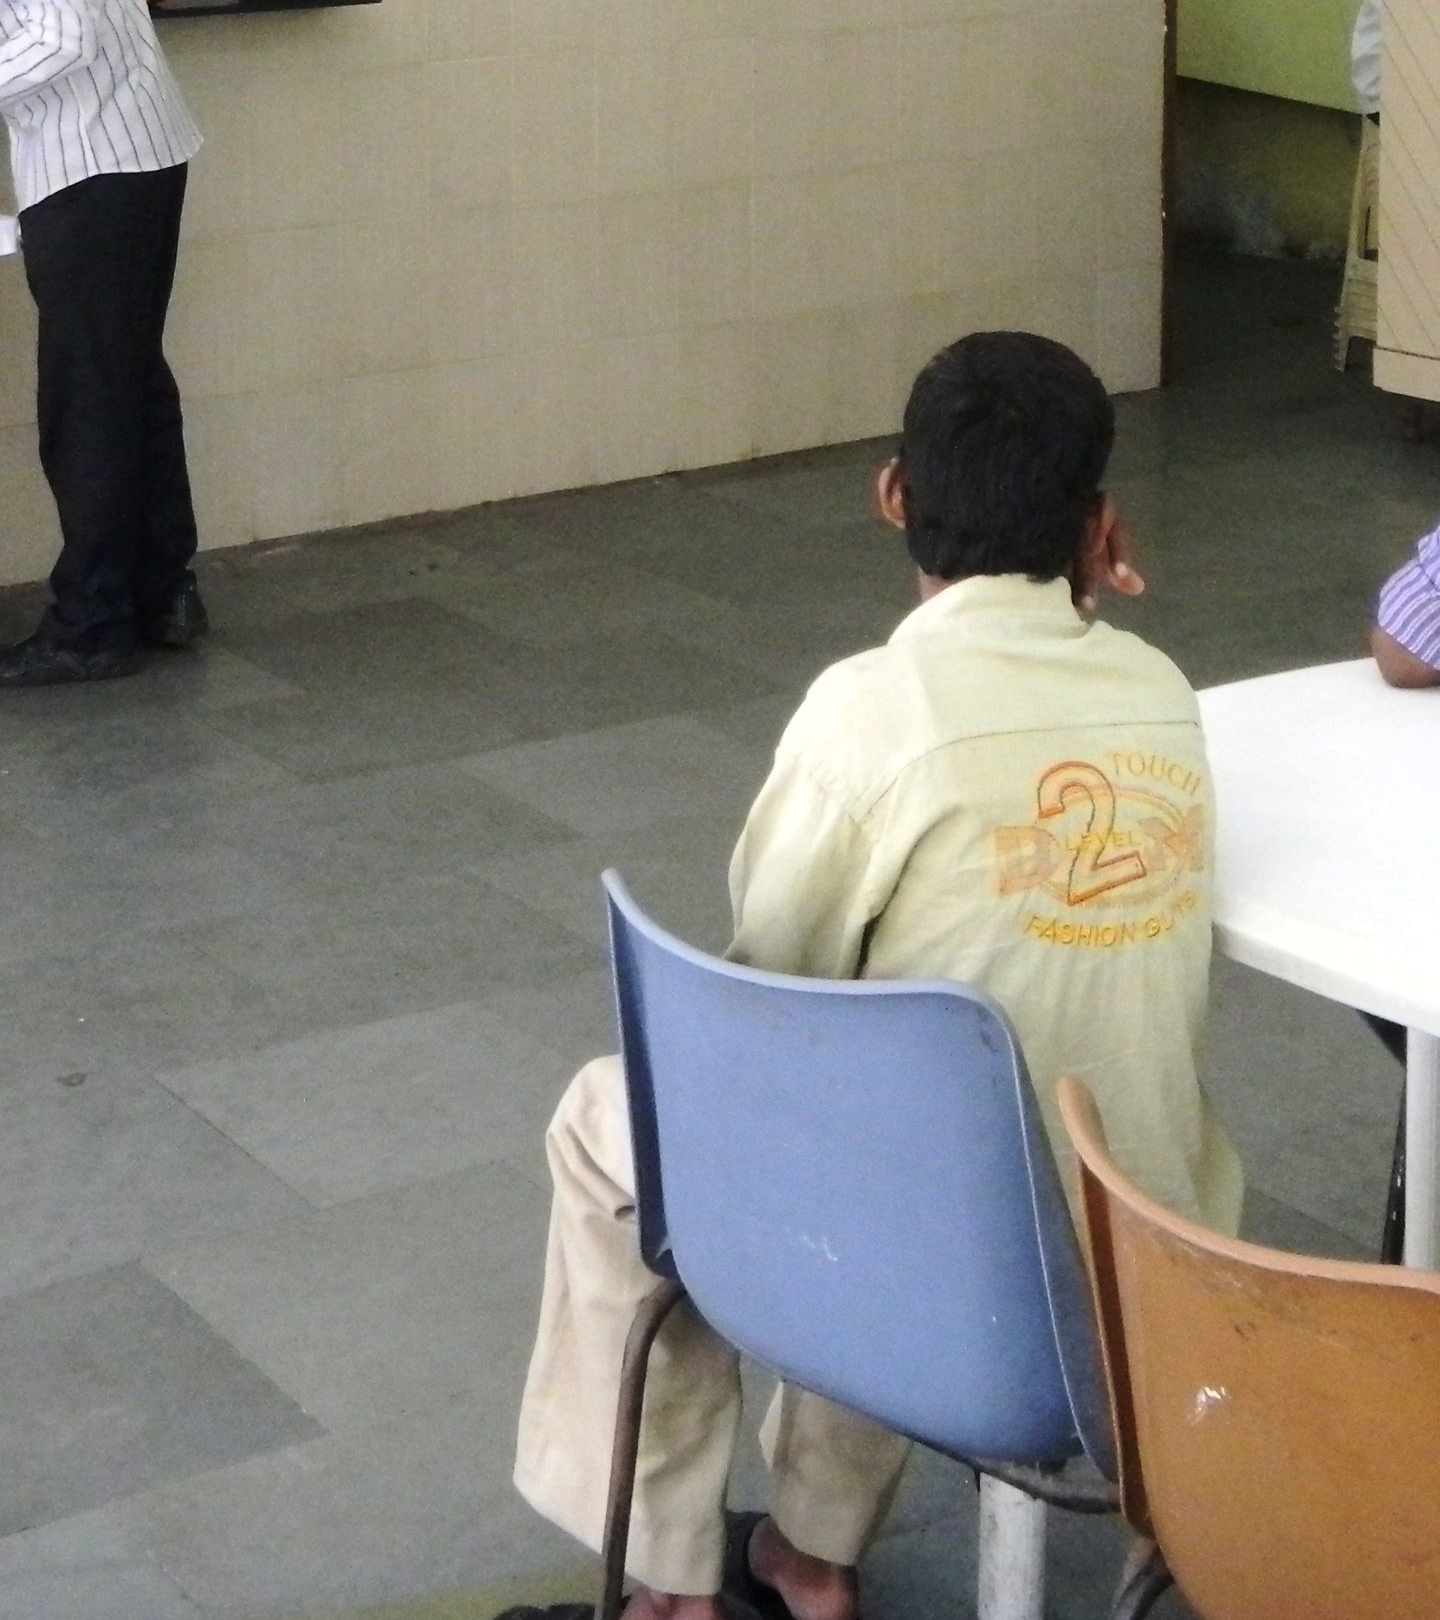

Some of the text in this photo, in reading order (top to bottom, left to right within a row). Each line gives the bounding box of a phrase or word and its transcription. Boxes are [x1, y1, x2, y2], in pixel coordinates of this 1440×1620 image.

[1111, 752, 1202, 796] TOUCH
[1037, 760, 1147, 906] 2
[1064, 830, 1140, 852] LEVEL
[1023, 914, 1137, 948] FASHION
